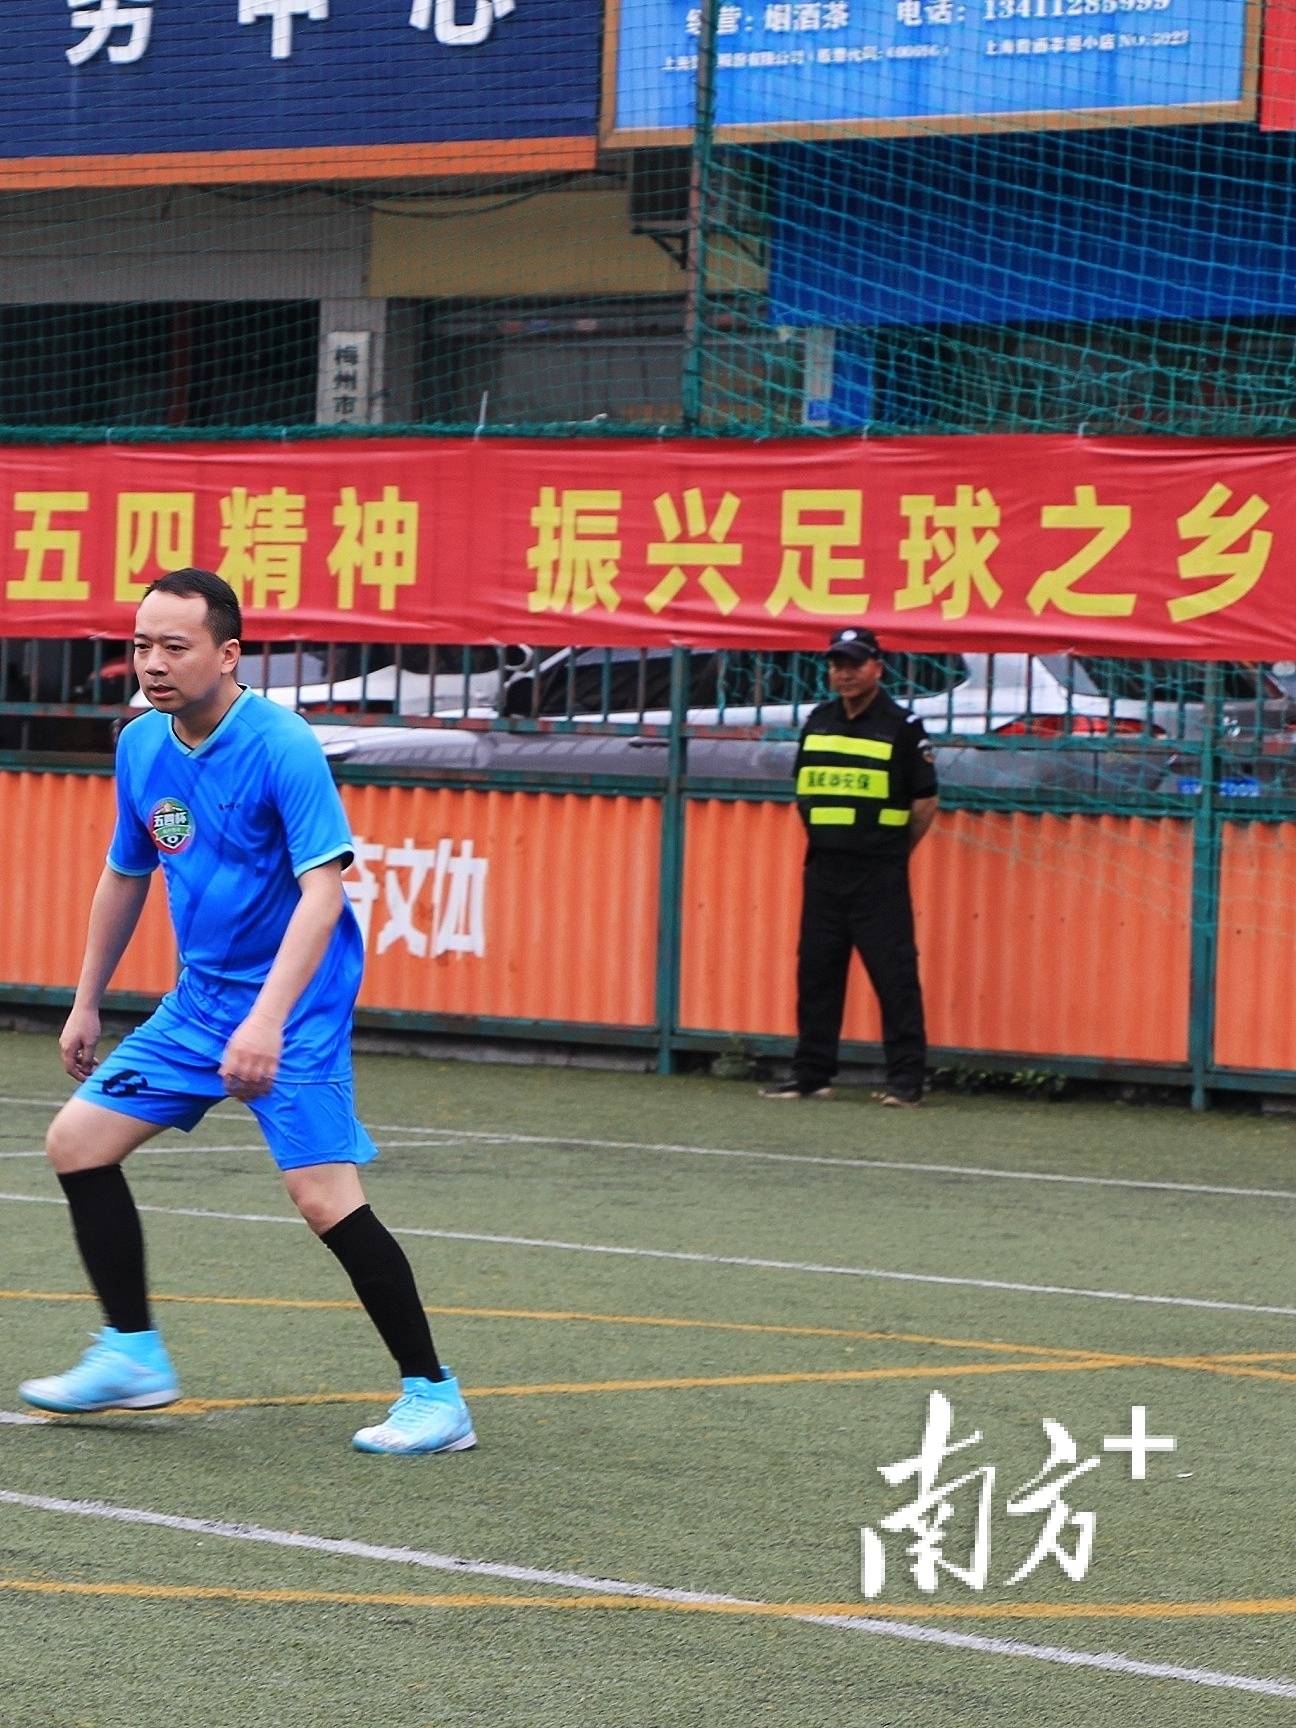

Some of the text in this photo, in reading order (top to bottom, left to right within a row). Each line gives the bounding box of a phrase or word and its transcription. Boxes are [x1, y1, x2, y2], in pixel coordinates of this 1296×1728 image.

[526, 482, 1274, 623] 振兴足球之乡
